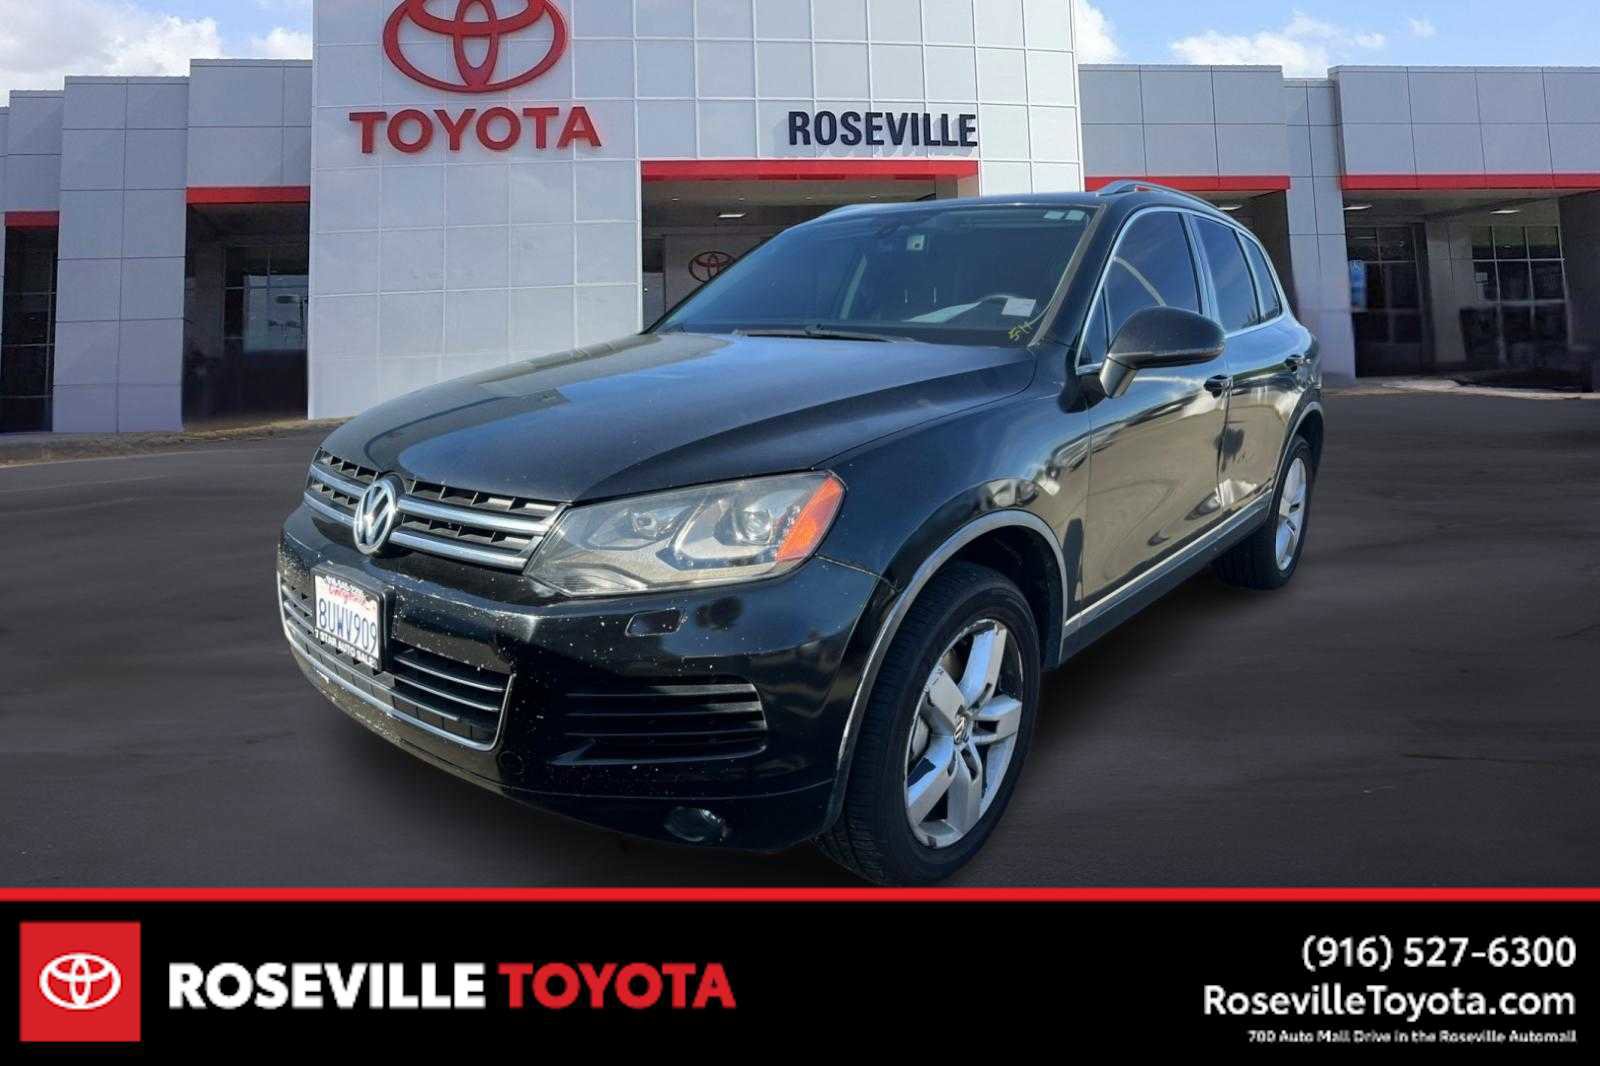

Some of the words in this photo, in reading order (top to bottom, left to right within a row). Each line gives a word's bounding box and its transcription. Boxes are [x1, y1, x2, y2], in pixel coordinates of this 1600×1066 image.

[349, 105, 602, 154] TOYOTA
[788, 110, 978, 147] ROSEVILLE
[318, 597, 377, 655] 8UWV909
